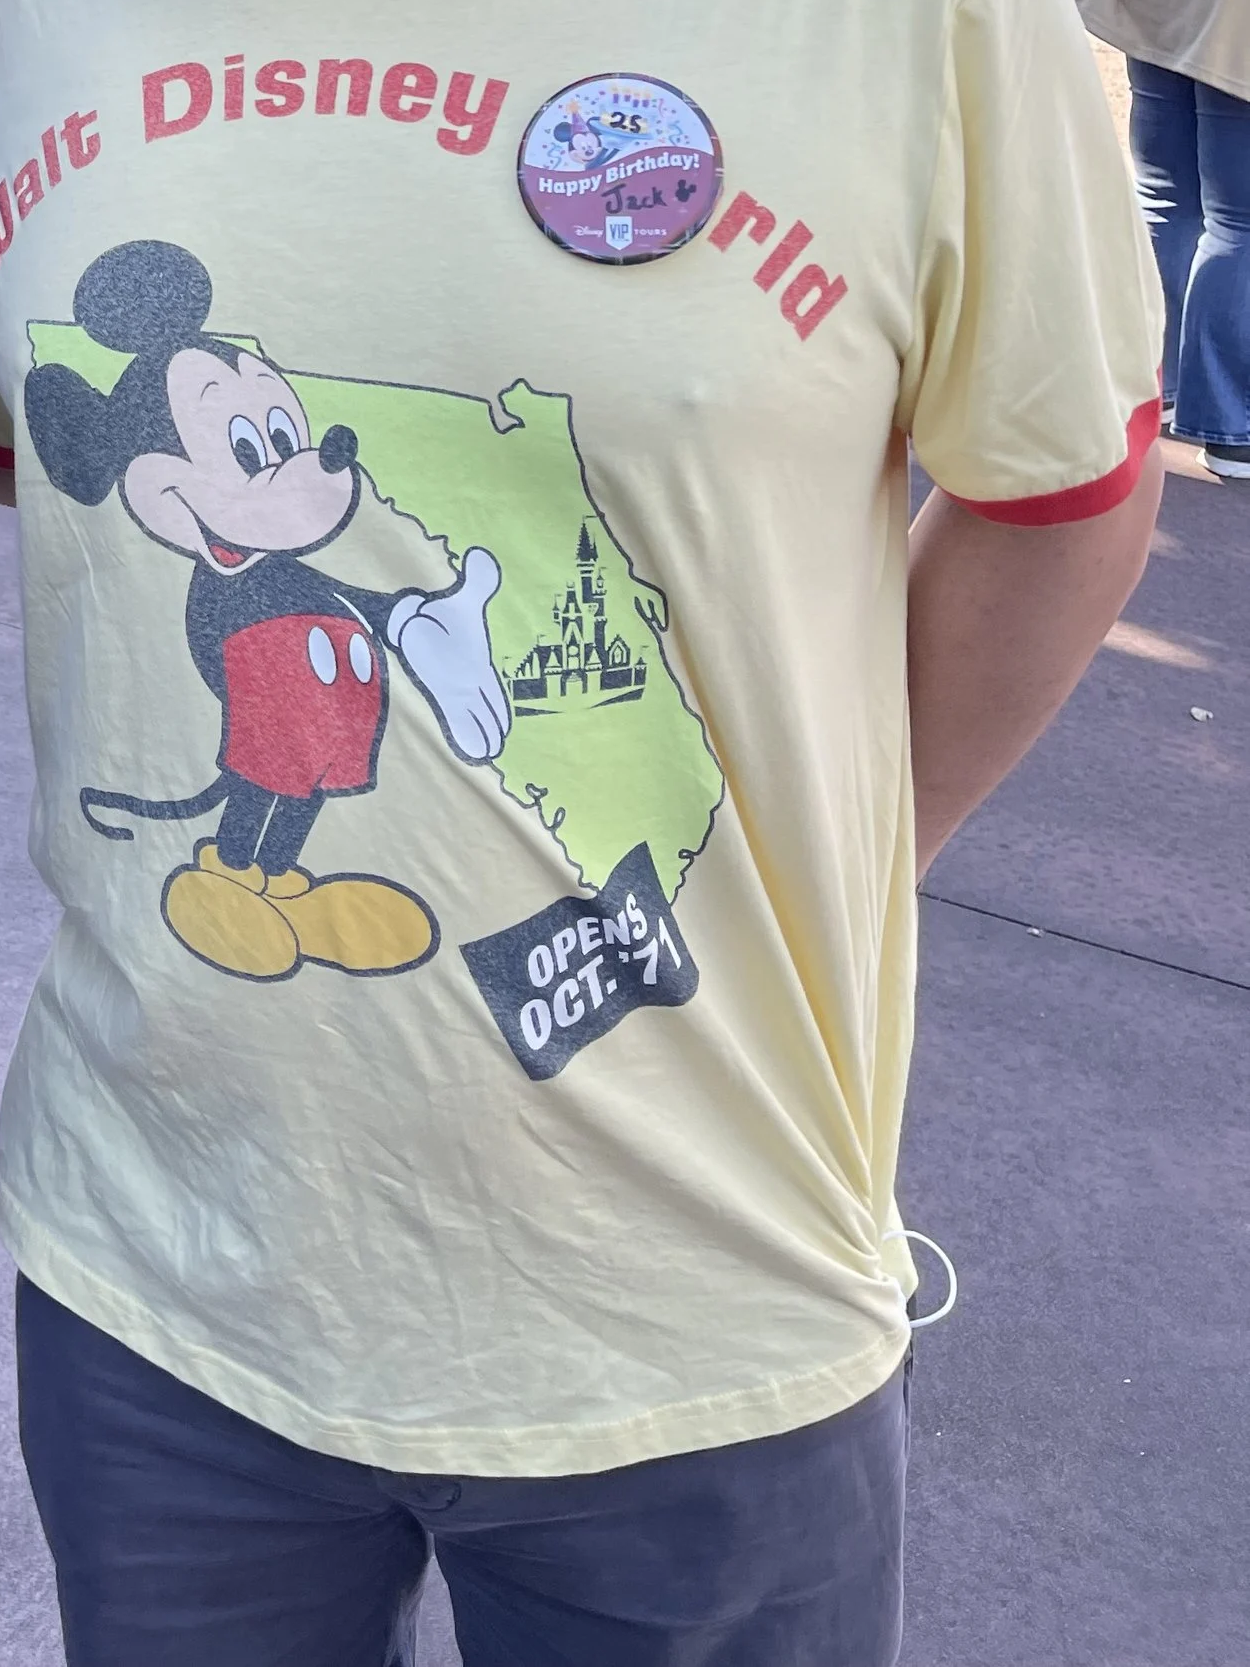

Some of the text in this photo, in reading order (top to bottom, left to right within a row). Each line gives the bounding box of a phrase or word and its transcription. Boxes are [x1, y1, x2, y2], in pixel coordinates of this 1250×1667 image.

[610, 111, 643, 134] 25
[538, 151, 700, 197] Happy Birthday!
[143, 54, 511, 156] Disney
[707, 191, 848, 343] rld
[601, 183, 668, 215] Jack
[573, 223, 667, 240] Disney VIP TOURS
[528, 892, 648, 988] OPENS
[519, 954, 618, 1051] OCT.
